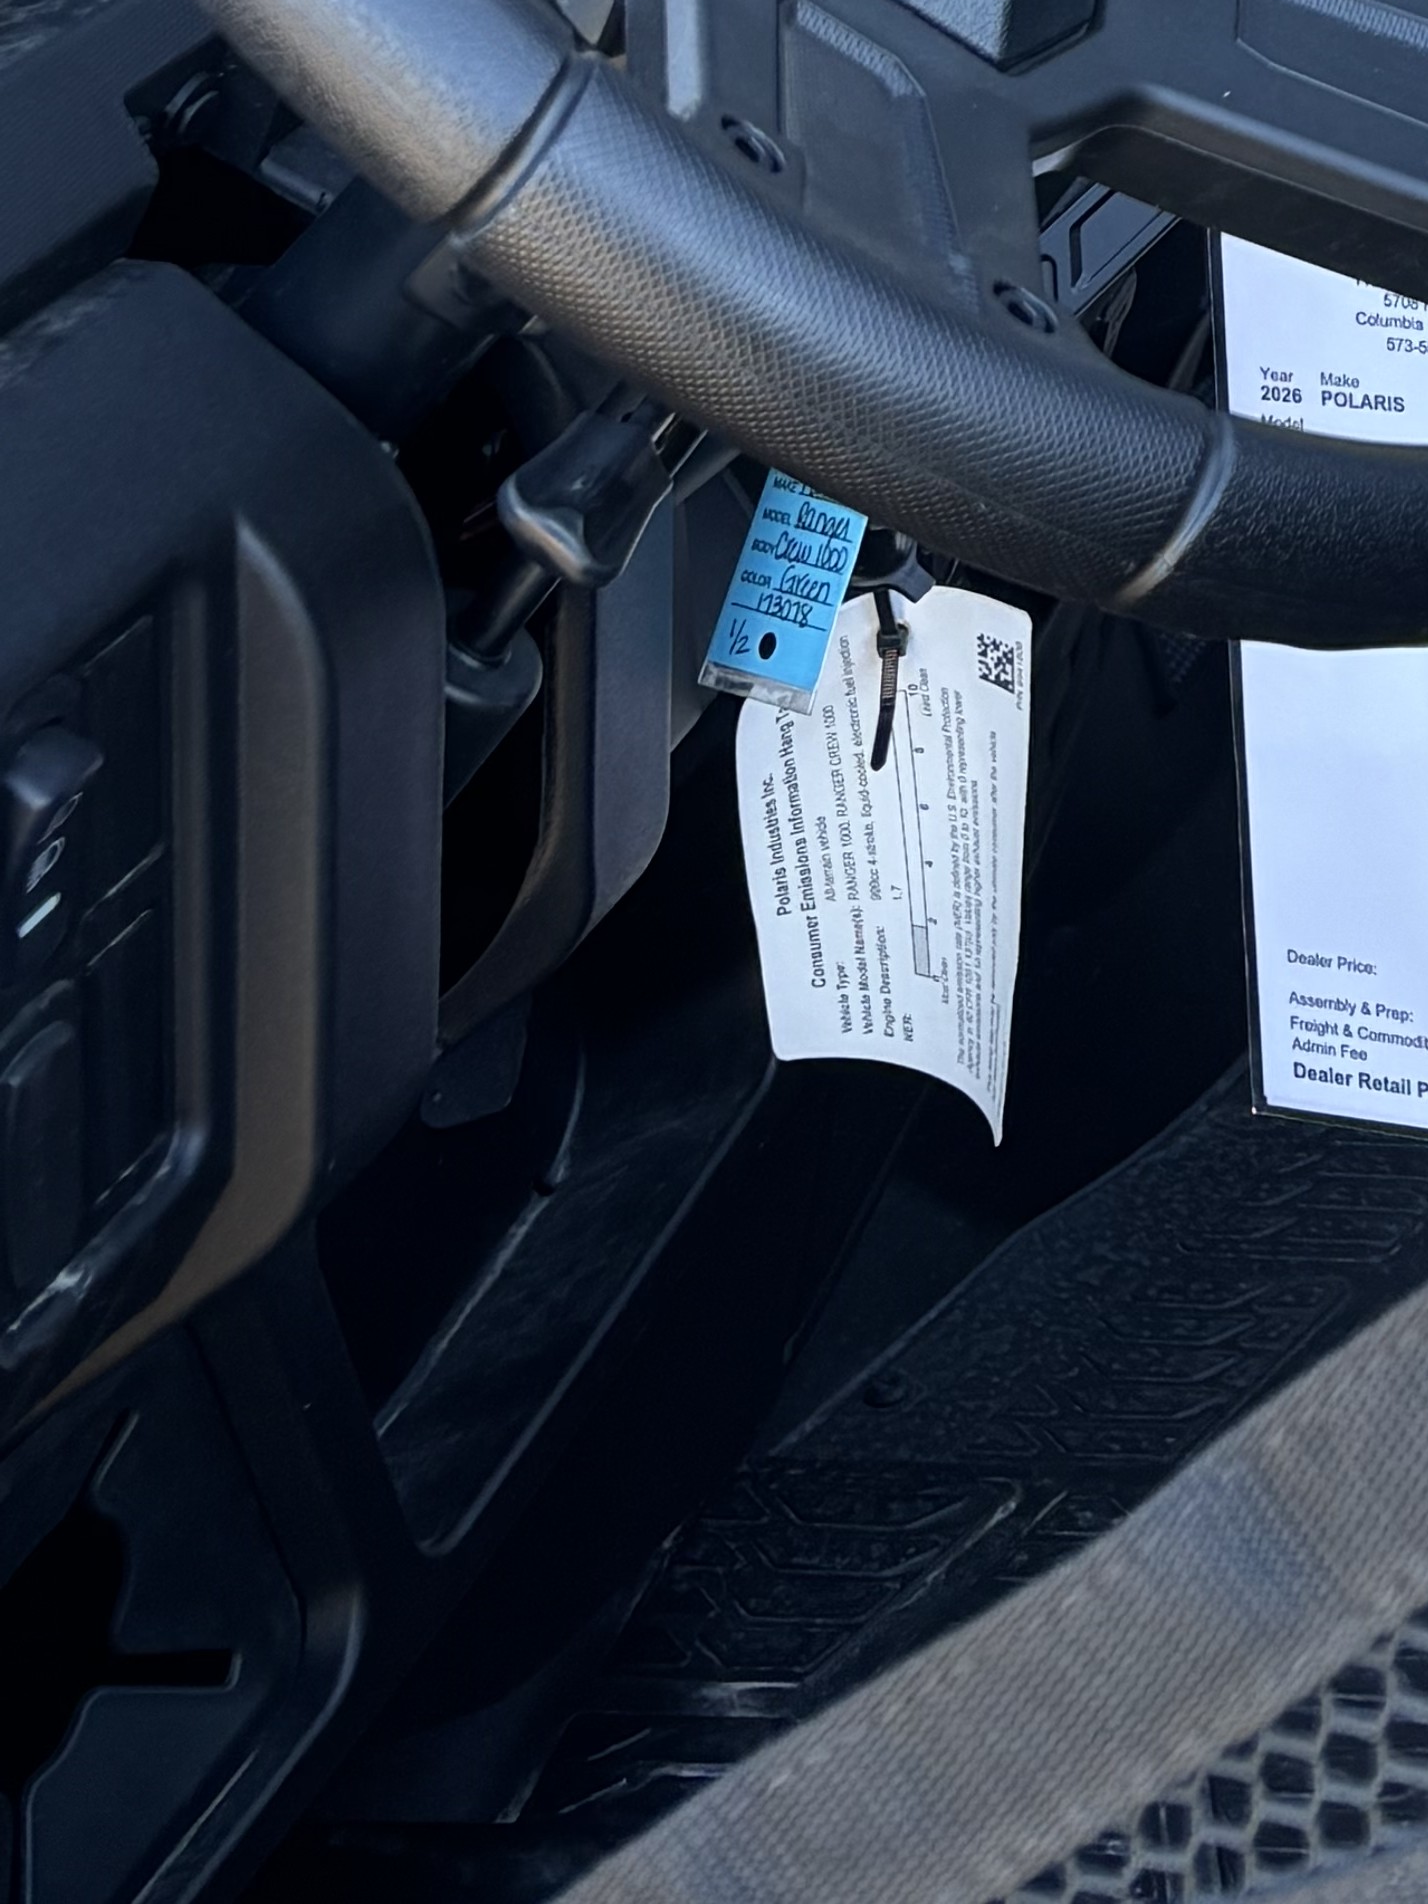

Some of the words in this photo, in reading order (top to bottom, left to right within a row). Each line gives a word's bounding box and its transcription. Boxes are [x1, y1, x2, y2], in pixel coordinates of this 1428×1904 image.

[1355, 310, 1424, 333] Columbia
[1260, 366, 1294, 383] Year
[1320, 371, 1360, 388] Make
[1260, 385, 1302, 404] 2026
[1320, 390, 1405, 412] POLARIS
[762, 507, 791, 525] MODEL
[774, 531, 812, 563] Crew
[740, 569, 772, 589] COLOR
[780, 564, 831, 603] Green
[839, 635, 856, 677] injection
[842, 677, 856, 696] fuel
[908, 683, 919, 696] 10
[822, 705, 836, 729] 1000
[849, 697, 863, 747] electronic
[778, 721, 794, 757] Hang
[825, 732, 841, 766] CREW
[761, 773, 774, 799] Inc.
[782, 758, 805, 835] Information
[831, 769, 848, 817] RANGER
[764, 798, 784, 865] Industries
[815, 816, 830, 851] vehicle
[772, 867, 792, 916] Polaris
[795, 838, 816, 911] Emissions
[842, 851, 860, 900] RANGER
[806, 916, 826, 988] Consumer
[876, 925, 891, 994] Description:
[1286, 947, 1333, 969] Dealer
[1337, 955, 1378, 976] Price:
[835, 961, 850, 990] Type:
[855, 957, 870, 991] Model
[837, 993, 852, 1033] Vehicle
[860, 994, 873, 1035] Vehicle
[882, 998, 895, 1037] Engine
[1288, 990, 1357, 1017] Assembly
[1361, 1001, 1371, 1016] &
[1375, 1003, 1414, 1024] Prep:
[1289, 1015, 1340, 1039] Freight
[1343, 1023, 1353, 1039] &
[1292, 1037, 1337, 1057] Admin
[1340, 1044, 1368, 1062] Fee
[1292, 1061, 1354, 1088] Dealer
[1358, 1071, 1412, 1097] Retail
